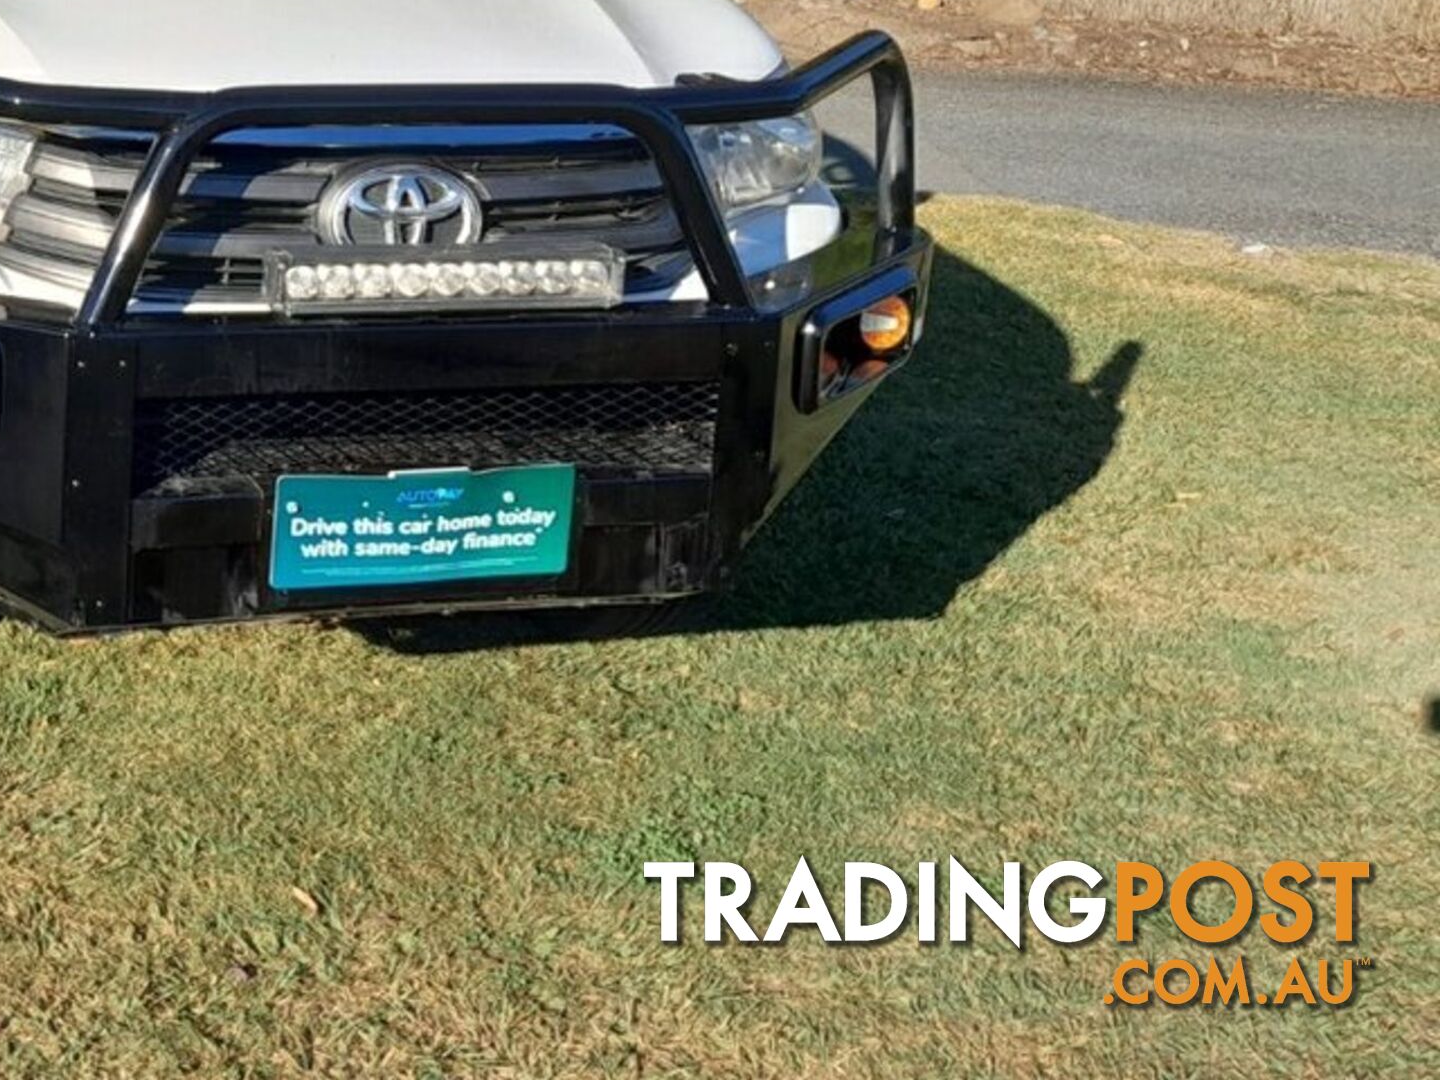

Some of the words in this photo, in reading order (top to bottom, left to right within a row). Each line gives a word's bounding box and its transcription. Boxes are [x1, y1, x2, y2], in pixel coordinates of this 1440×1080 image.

[290, 517, 348, 536] Drive
[353, 516, 394, 535] this
[398, 519, 432, 535] car
[436, 514, 492, 533] home
[496, 507, 556, 528] today
[300, 539, 348, 558] with
[354, 534, 458, 557] same-day
